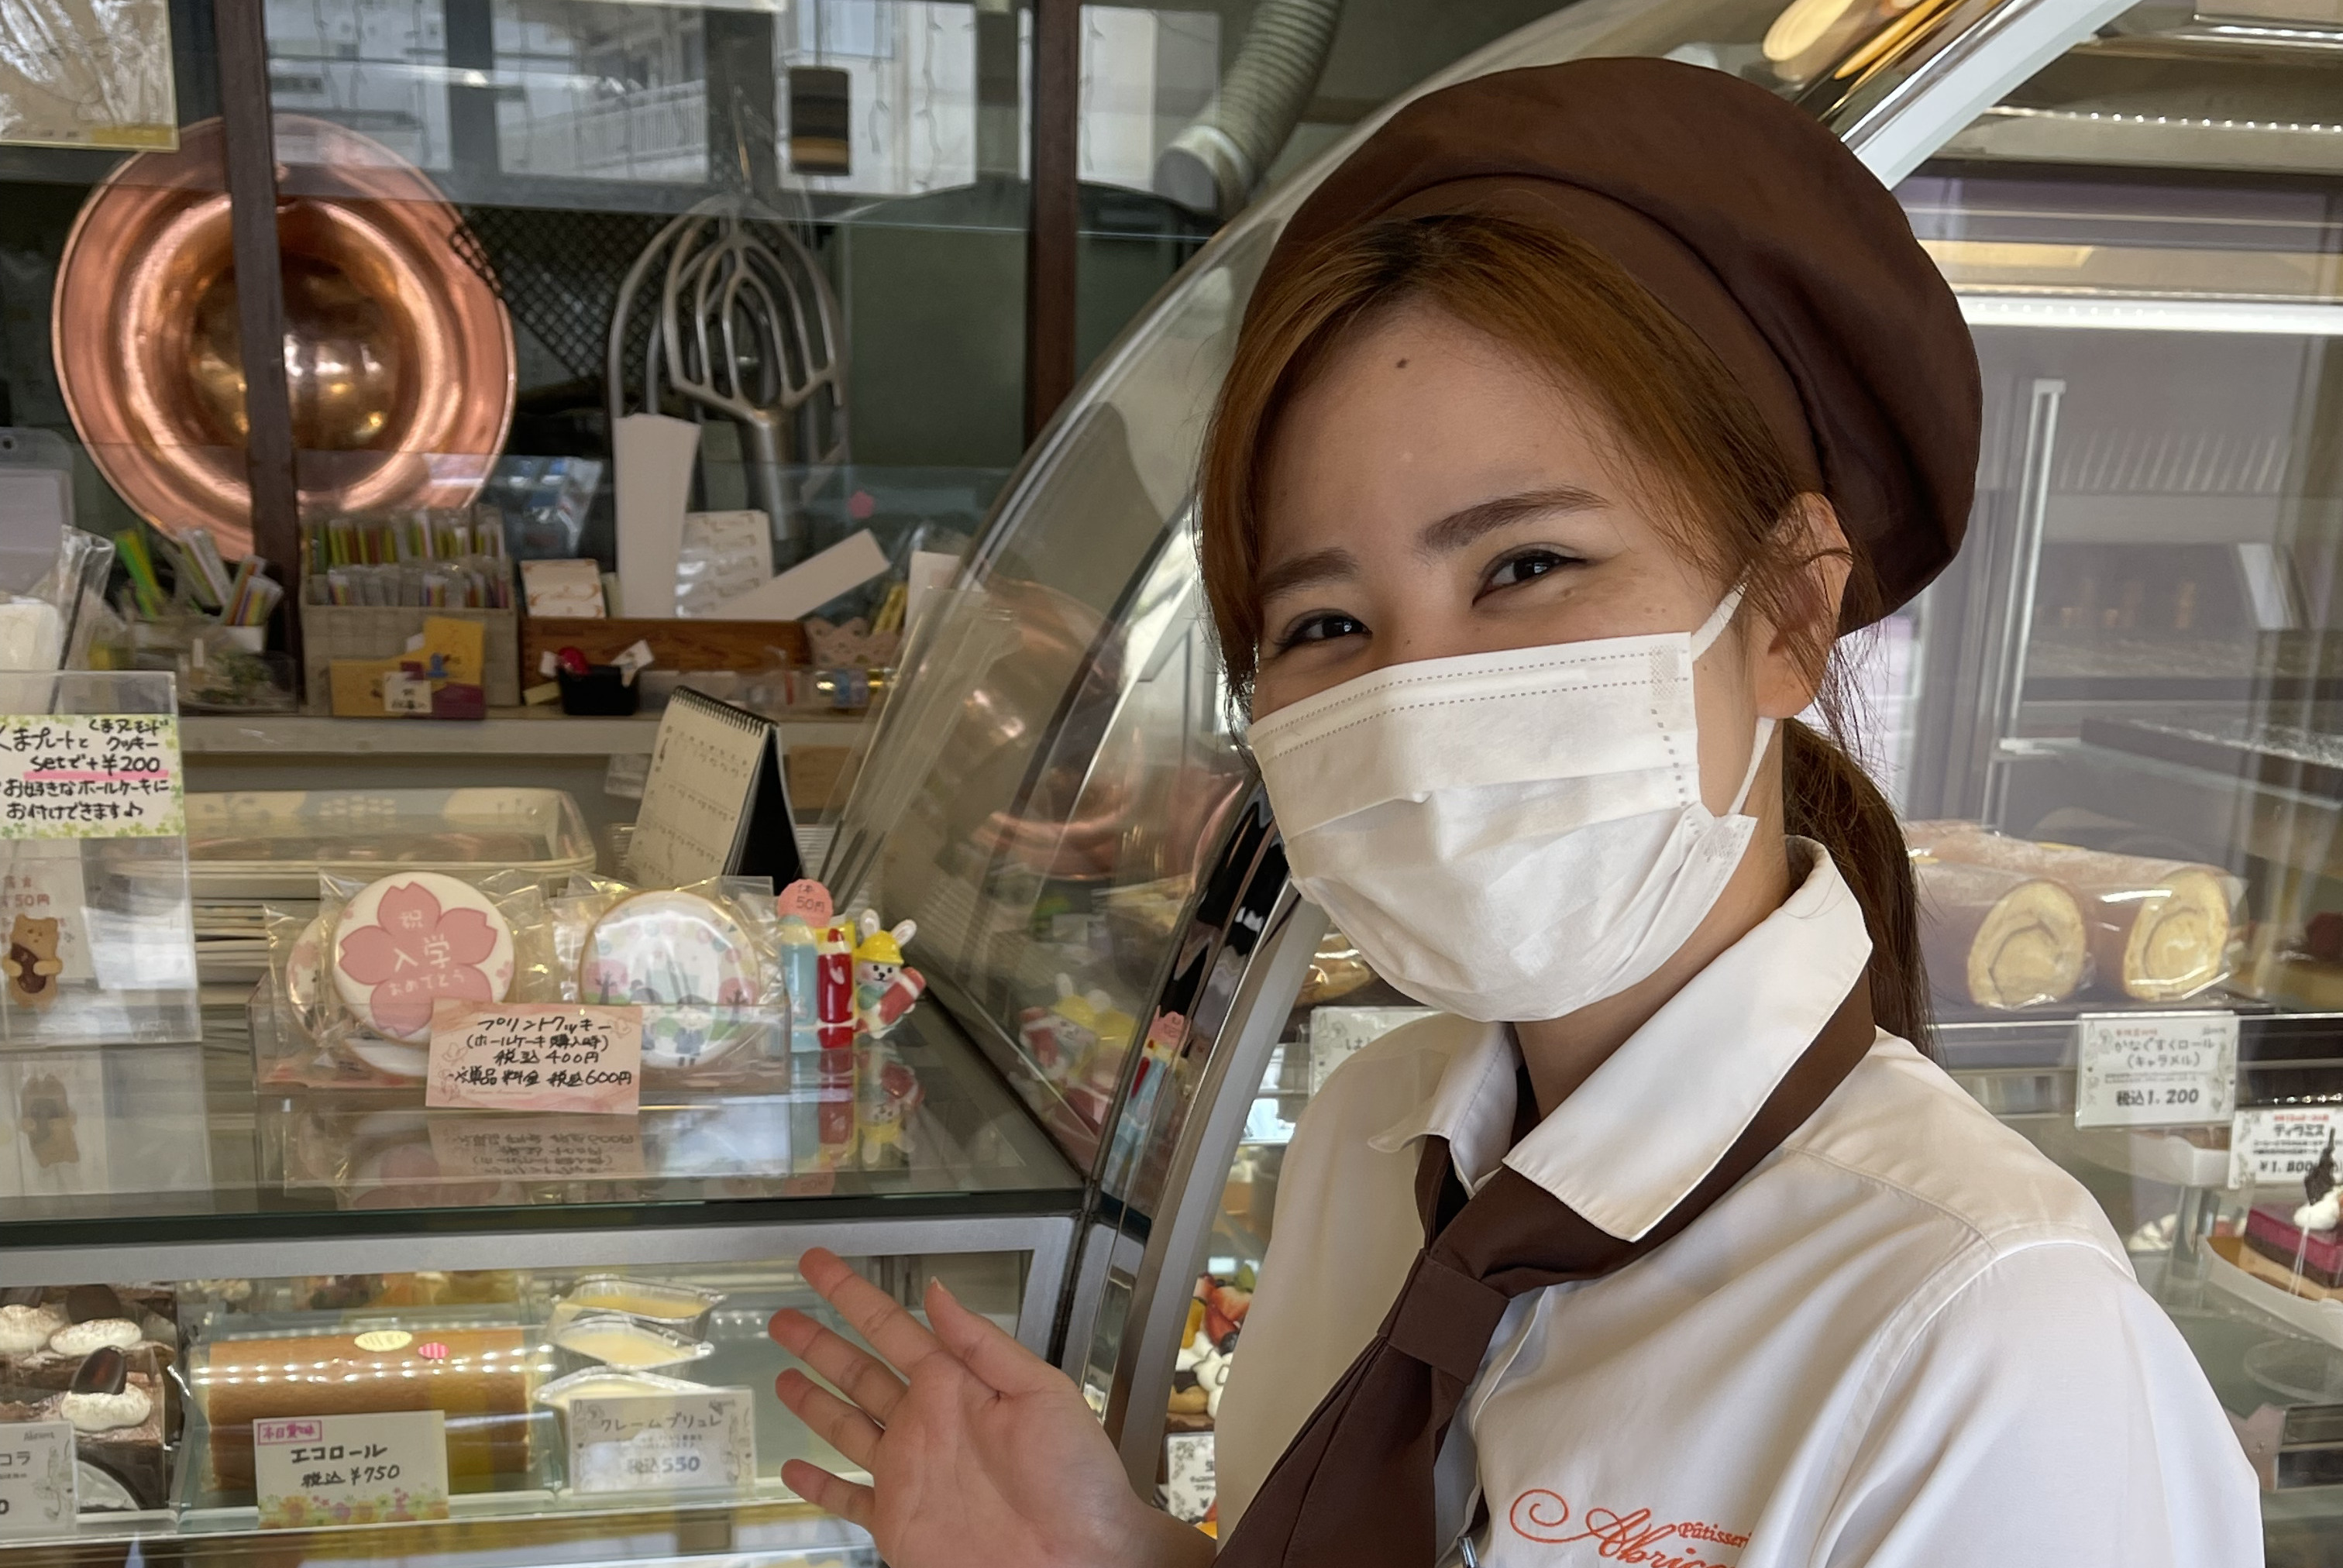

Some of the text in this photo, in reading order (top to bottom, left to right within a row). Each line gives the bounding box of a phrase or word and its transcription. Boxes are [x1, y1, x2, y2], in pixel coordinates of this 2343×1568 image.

[291, 1443, 388, 1464] エコロール
